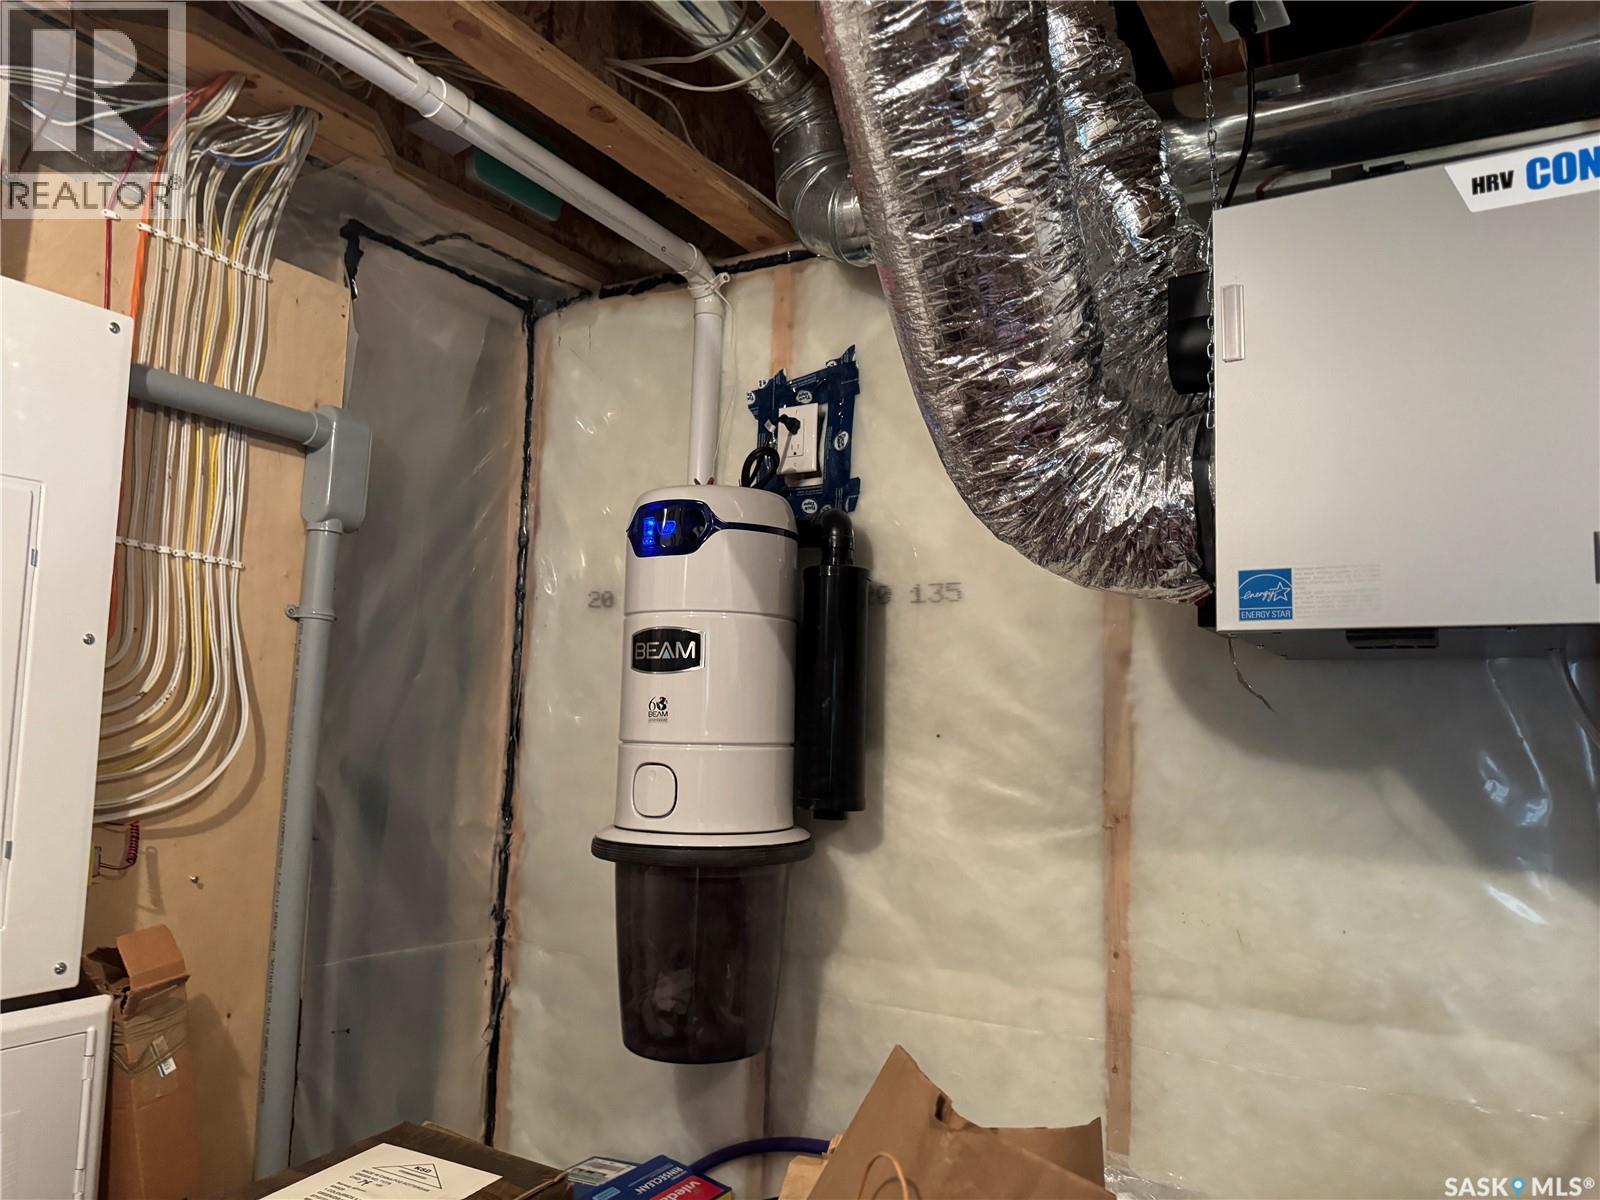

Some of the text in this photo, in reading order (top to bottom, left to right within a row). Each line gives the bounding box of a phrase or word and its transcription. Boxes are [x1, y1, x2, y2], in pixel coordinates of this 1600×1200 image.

[1471, 145, 1600, 196] HRV CON
[909, 582, 962, 604] 135
[1241, 610, 1291, 619] ENERGY STAR
[634, 641, 696, 660] BEAM
[647, 710, 668, 718] BEAM
